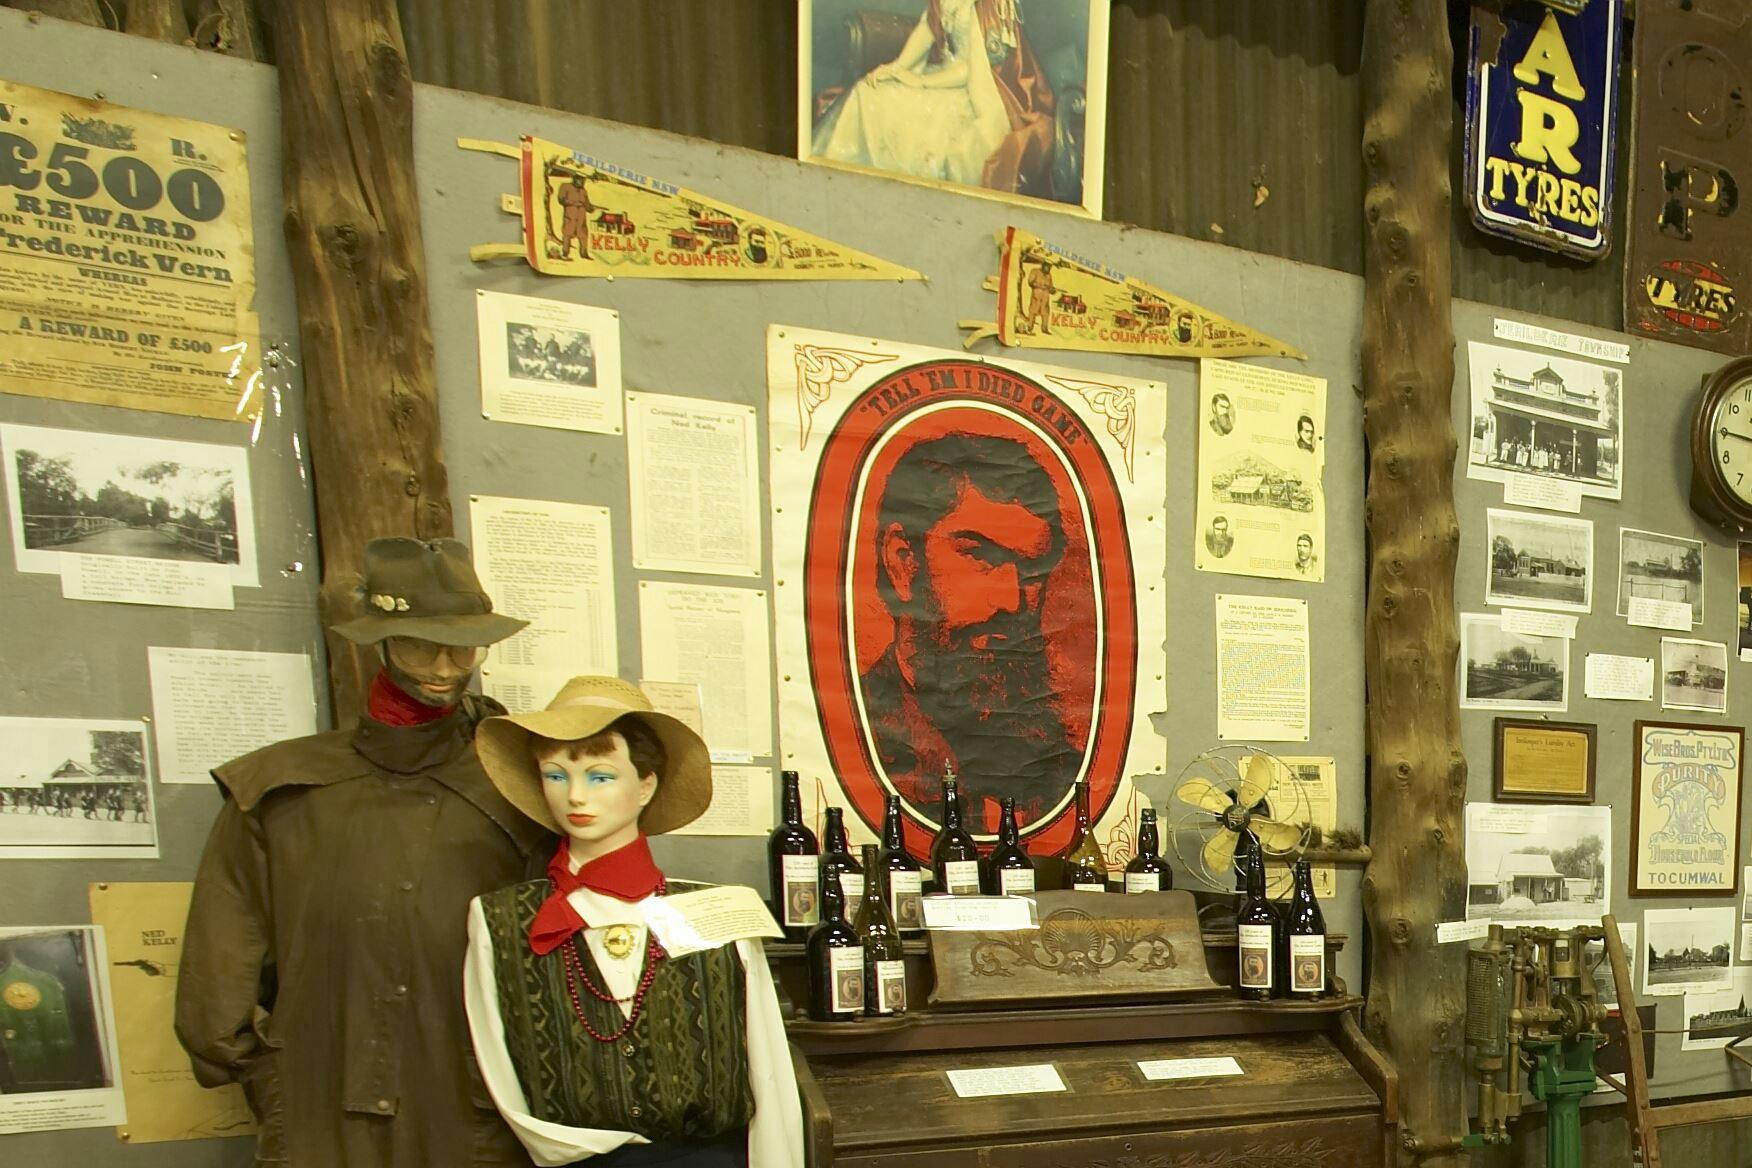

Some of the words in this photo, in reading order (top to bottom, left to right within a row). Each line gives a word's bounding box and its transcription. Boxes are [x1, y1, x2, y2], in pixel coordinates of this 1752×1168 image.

[170, 137, 208, 161] R.
[0, 131, 225, 222] £500
[573, 151, 647, 187] JERILDERIE
[651, 178, 682, 196] NSW
[1486, 156, 1600, 228] TYRES
[15, 194, 197, 241] REWARD
[34, 218, 76, 235] THE
[85, 228, 227, 260] APPREHENSION
[591, 234, 650, 253] KELLY
[0, 227, 151, 270] rederick
[153, 254, 234, 283] Vern
[654, 250, 741, 268] COUNTRY
[78, 267, 148, 287] WHEREAS
[1050, 313, 1098, 330] KELLY
[19, 316, 33, 330] A
[40, 318, 130, 344] REWARD
[138, 333, 162, 348] OF
[169, 336, 213, 354] £500
[1099, 328, 1170, 345] COUNTRY
[964, 370, 972, 388] I
[977, 370, 1026, 403] DIED
[1744, 389, 1752, 402] 11
[650, 407, 688, 418] Criminal
[1728, 403, 1740, 415] 10
[1722, 450, 1730, 464] 8
[1736, 473, 1744, 486] 7
[1648, 872, 1725, 885] TOCUMWAL
[141, 930, 166, 938] NED
[142, 936, 178, 946] KELLY
